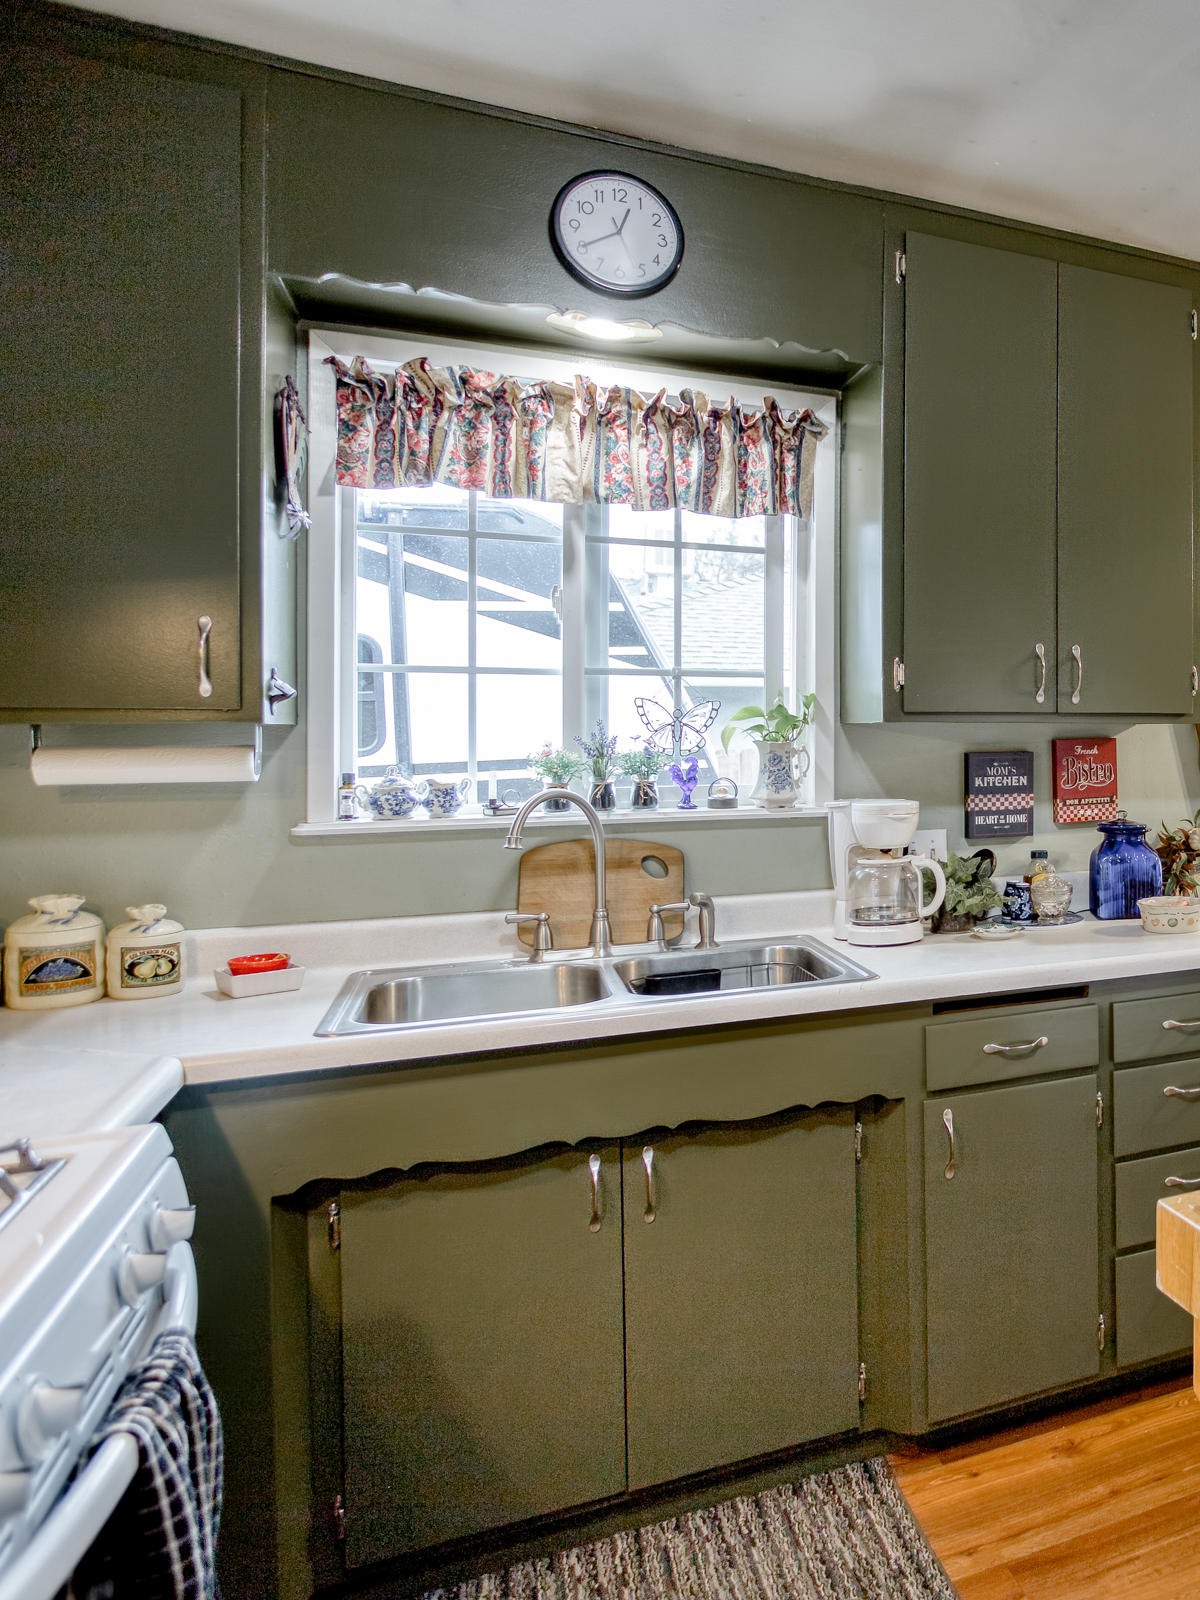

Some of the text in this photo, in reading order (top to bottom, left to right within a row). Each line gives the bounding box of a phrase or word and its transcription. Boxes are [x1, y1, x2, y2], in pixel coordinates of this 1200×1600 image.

[594, 189, 604, 203] 11
[612, 188, 628, 203] 12
[577, 200, 594, 215] 10
[638, 197, 642, 210] 1
[568, 219, 580, 233] 9
[651, 213, 662, 227] 2
[657, 233, 668, 248] 3
[576, 241, 588, 255] 8
[597, 257, 604, 271] 7
[652, 253, 660, 266] 4
[615, 265, 626, 278] 6
[638, 263, 646, 278] 5
[1074, 745, 1099, 755] French
[986, 766, 1017, 776] MOM'S
[1061, 756, 1115, 791] Bistro
[975, 776, 1028, 787] KITCHEN
[975, 815, 999, 825] HEART
[1006, 813, 1028, 824] HOME
